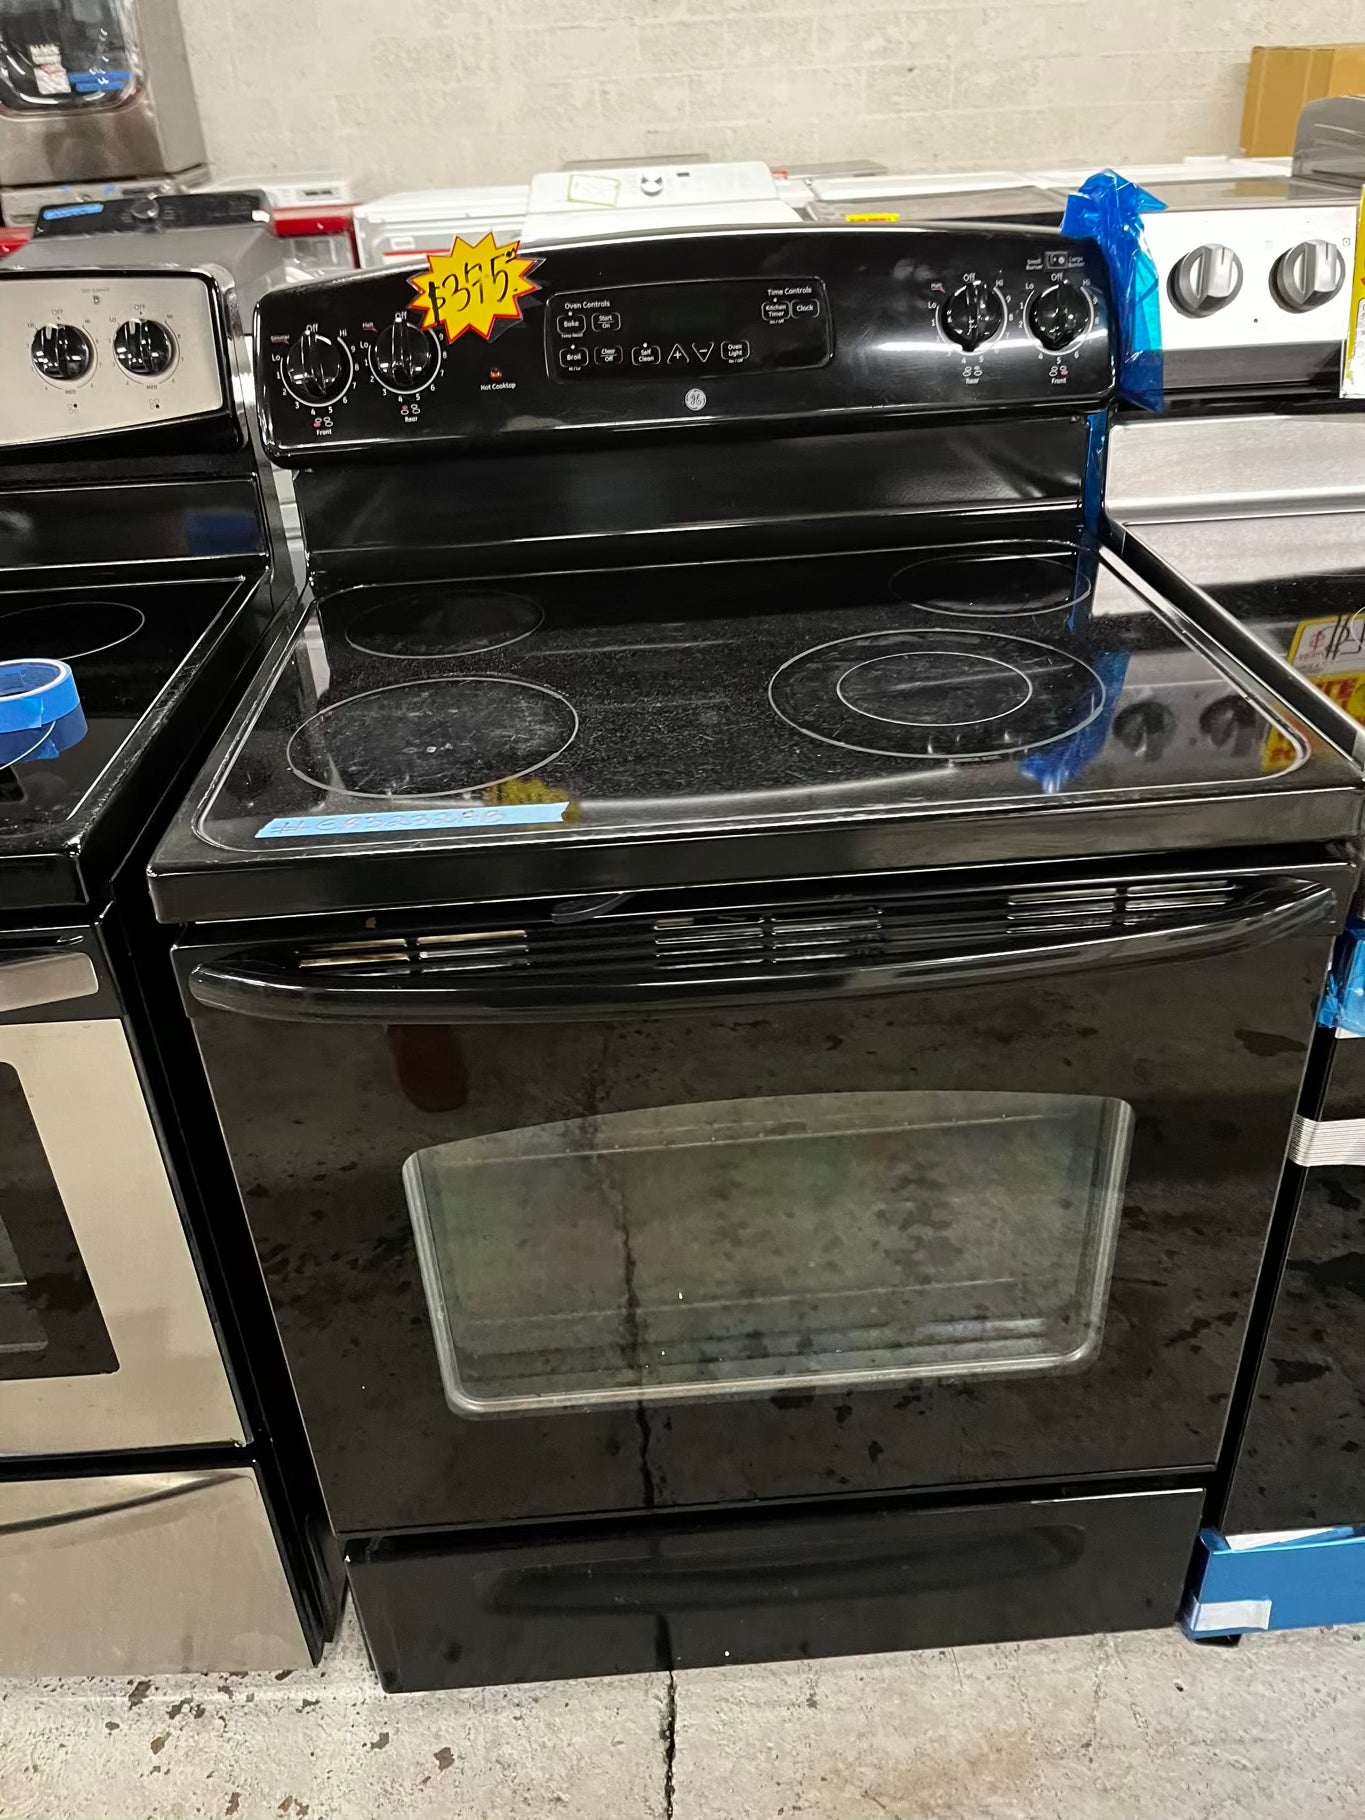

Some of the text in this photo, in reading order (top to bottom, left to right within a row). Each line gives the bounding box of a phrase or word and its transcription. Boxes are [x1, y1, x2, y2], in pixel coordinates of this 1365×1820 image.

[963, 273, 976, 282] Off
[1051, 272, 1063, 281] Off
[785, 285, 812, 295] Controls
[564, 300, 610, 310] Oven Controls
[796, 304, 814, 312] Clock
[928, 301, 936, 309] Lo
[395, 311, 407, 320] Off
[306, 323, 319, 333] Off
[563, 320, 579, 328] Bake
[339, 329, 347, 337] Hi
[360, 341, 369, 349] Lo
[271, 353, 281, 362] Lo
[567, 353, 581, 361] Broil
[492, 382, 516, 391] Cooktop
